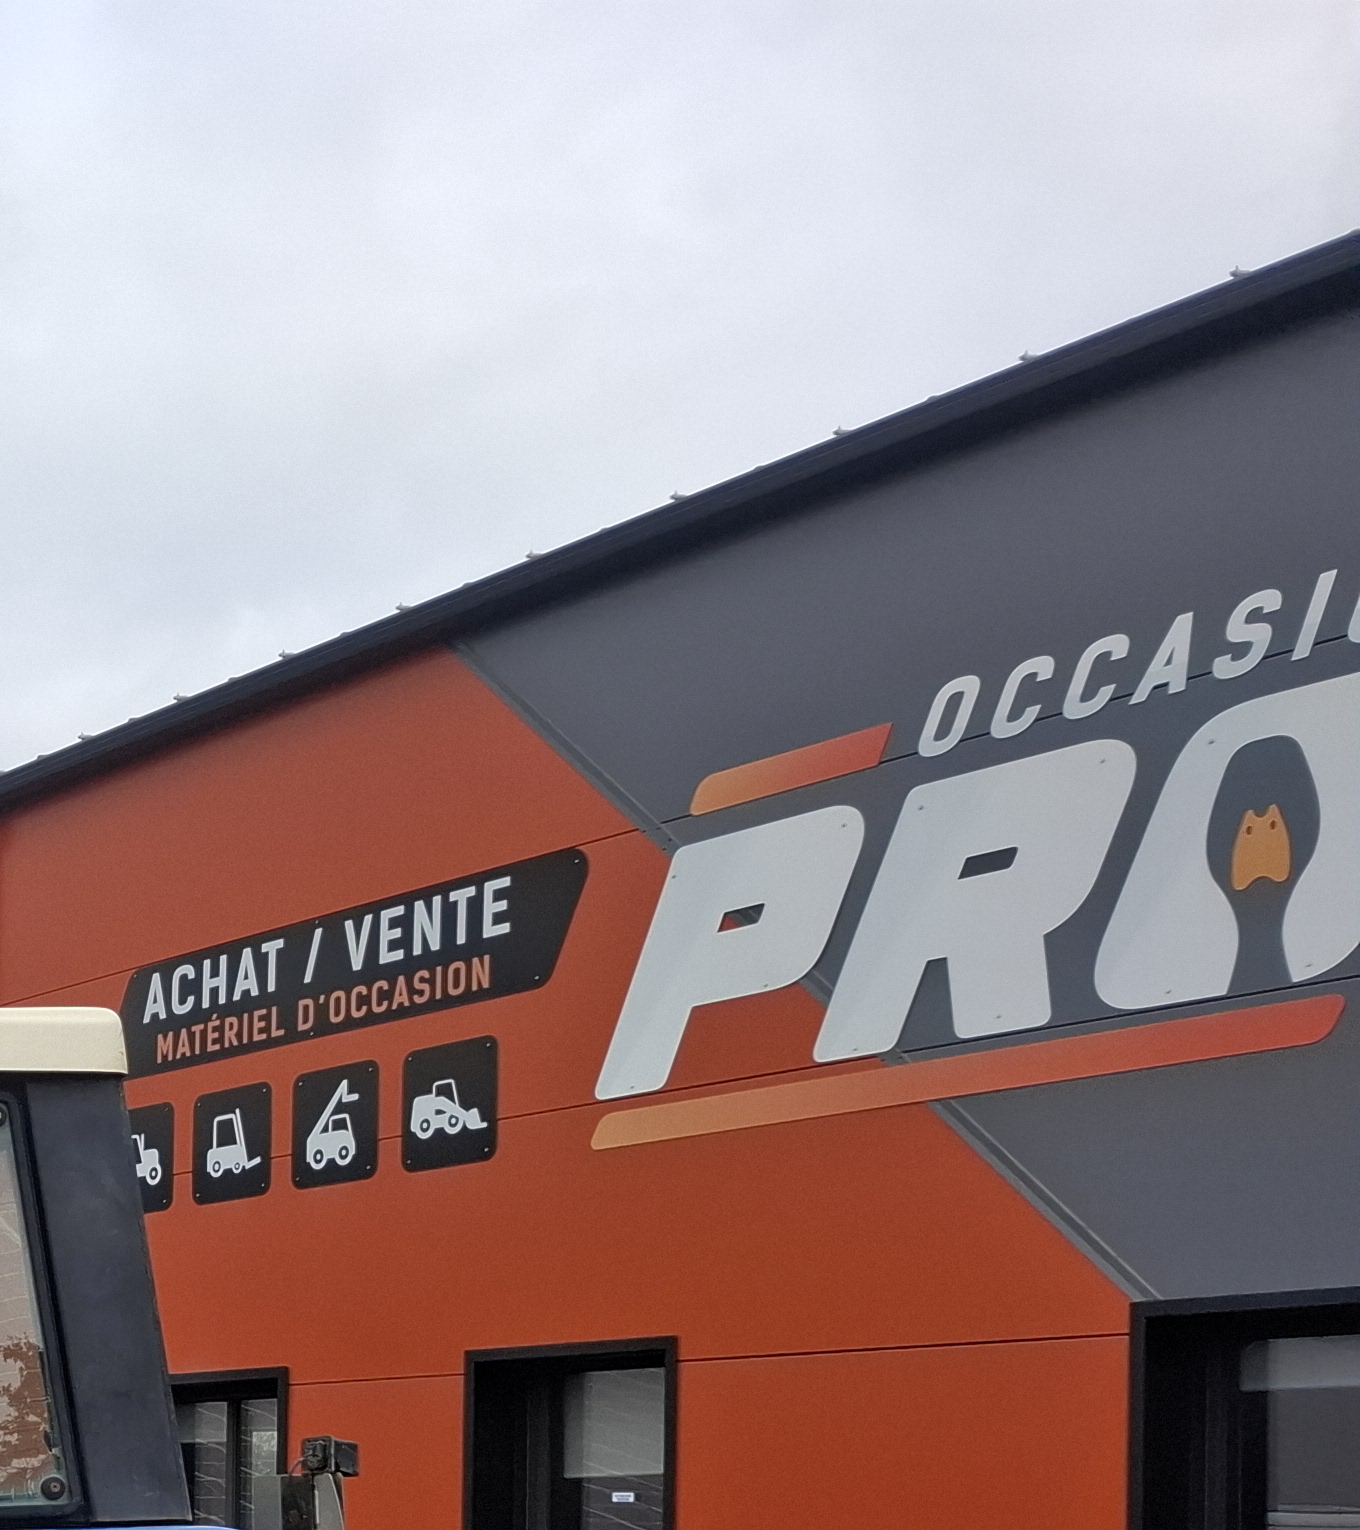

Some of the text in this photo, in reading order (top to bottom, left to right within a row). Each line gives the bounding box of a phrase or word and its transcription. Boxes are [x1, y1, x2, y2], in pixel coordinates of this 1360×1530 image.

[917, 568, 1360, 758] OCCASI
[142, 876, 512, 1024] ACHAT / VENTE
[156, 954, 491, 1064] MATÉRIEL D'OCCASION
